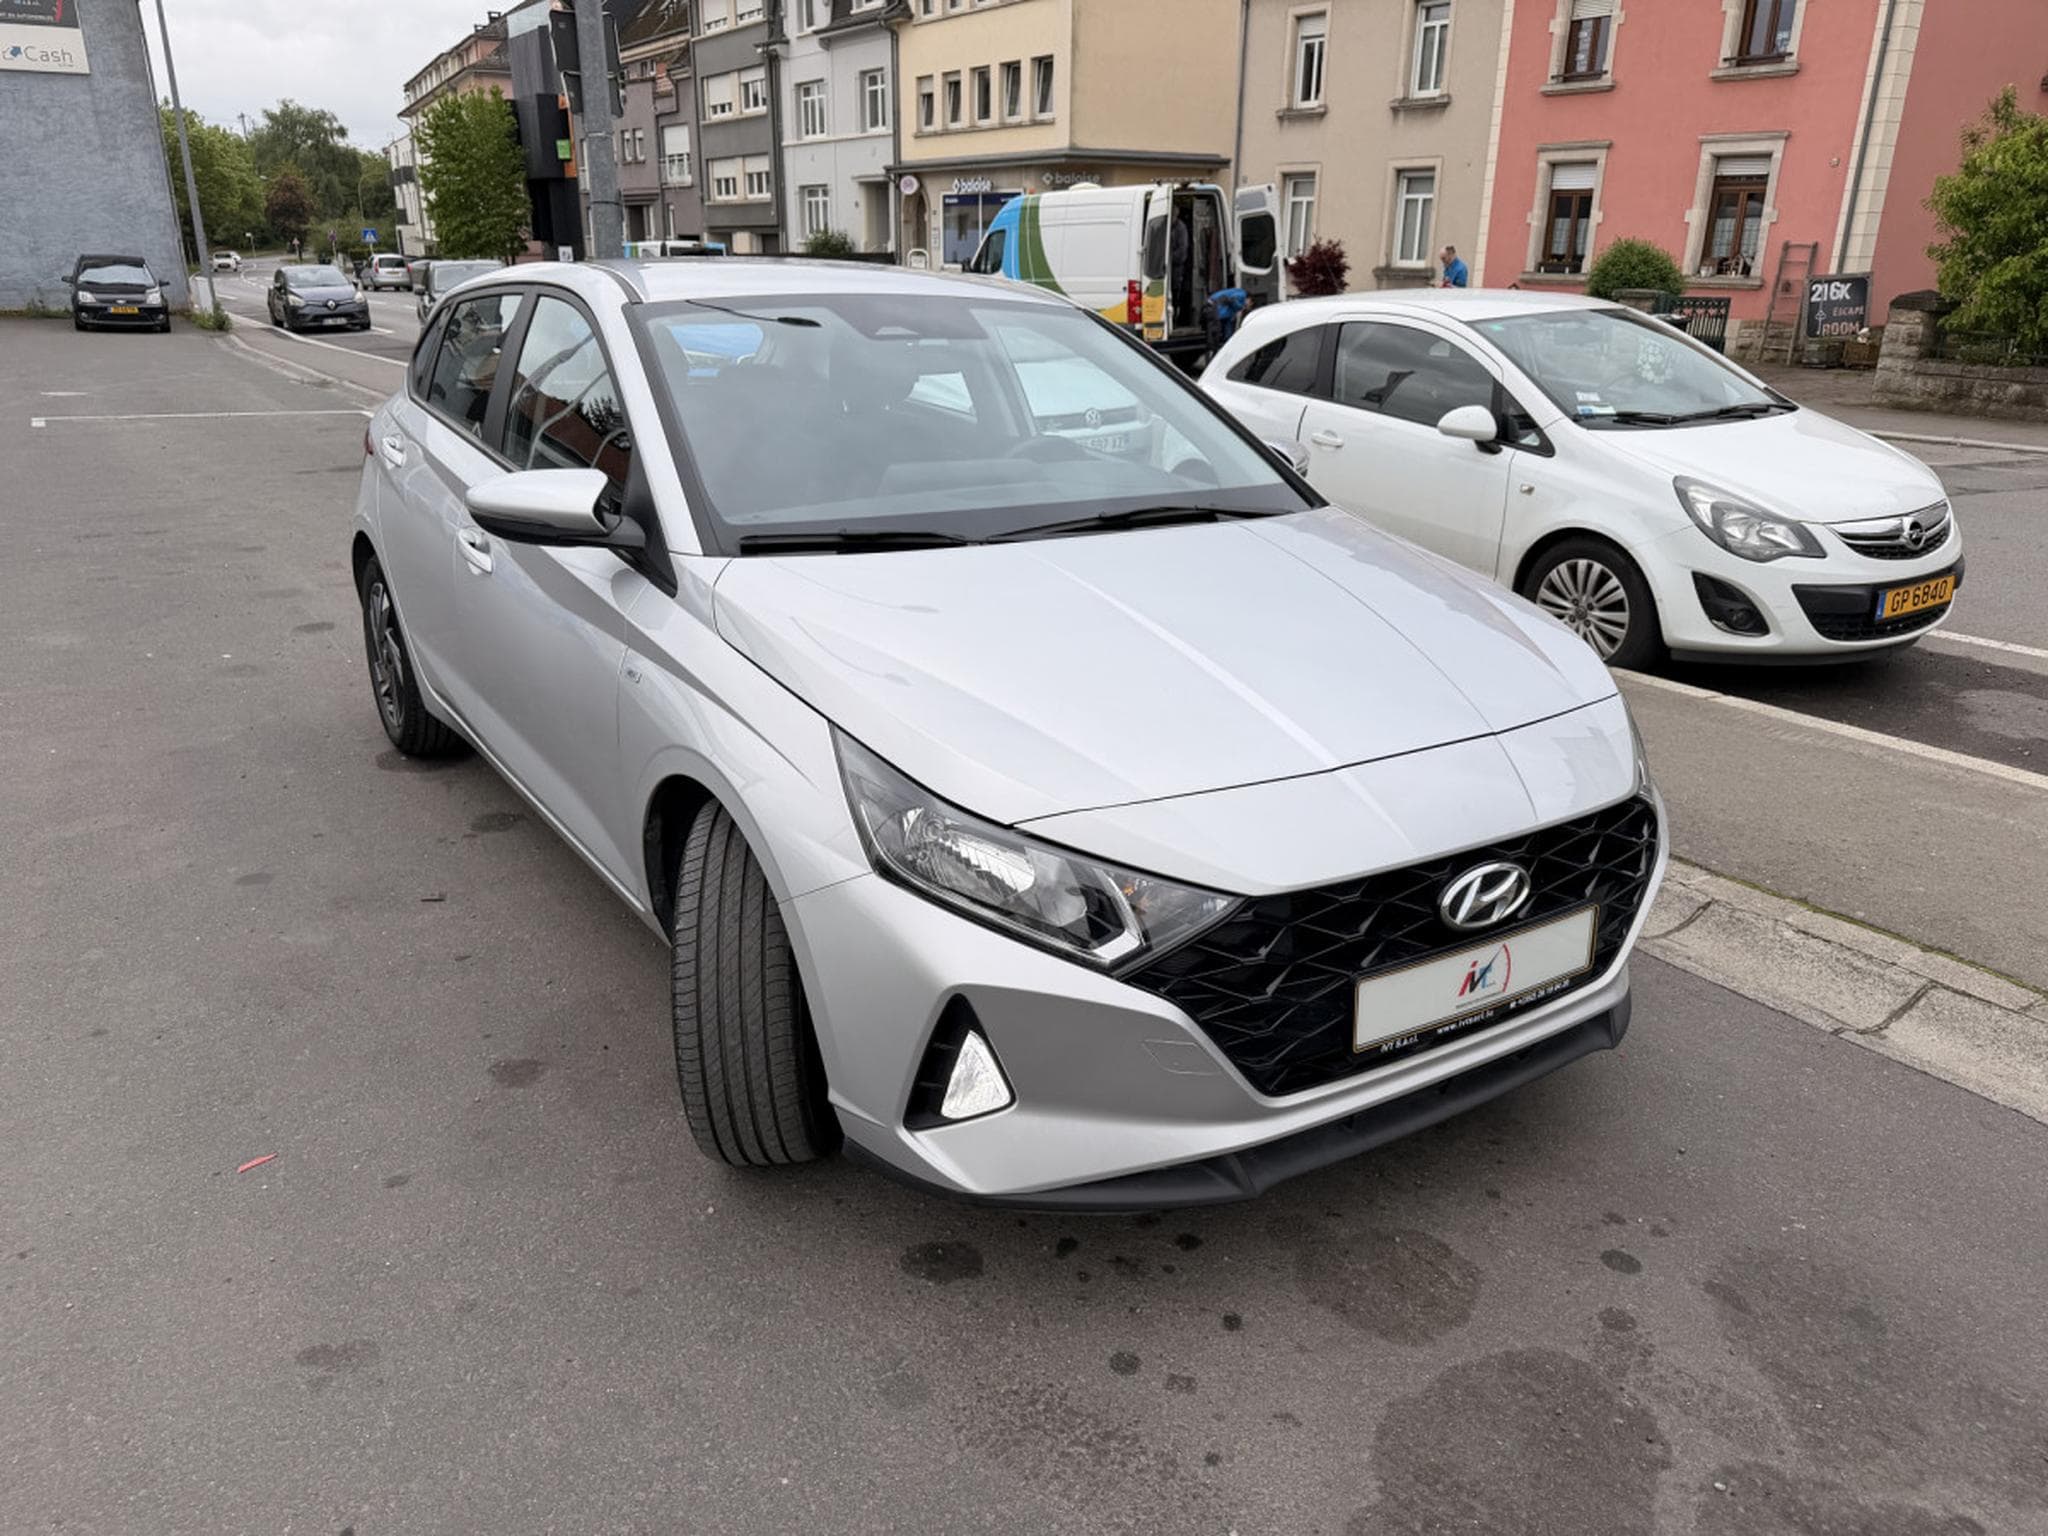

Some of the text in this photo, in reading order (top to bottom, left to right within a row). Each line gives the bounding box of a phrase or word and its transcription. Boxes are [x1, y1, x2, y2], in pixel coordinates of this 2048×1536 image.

[23, 45, 73, 63] Cash
[960, 177, 992, 193] baloise
[1055, 170, 1100, 184] baloise
[1810, 282, 1852, 303] 216K
[1822, 322, 1862, 337] ROOM
[1890, 579, 1948, 613] GP 6840
